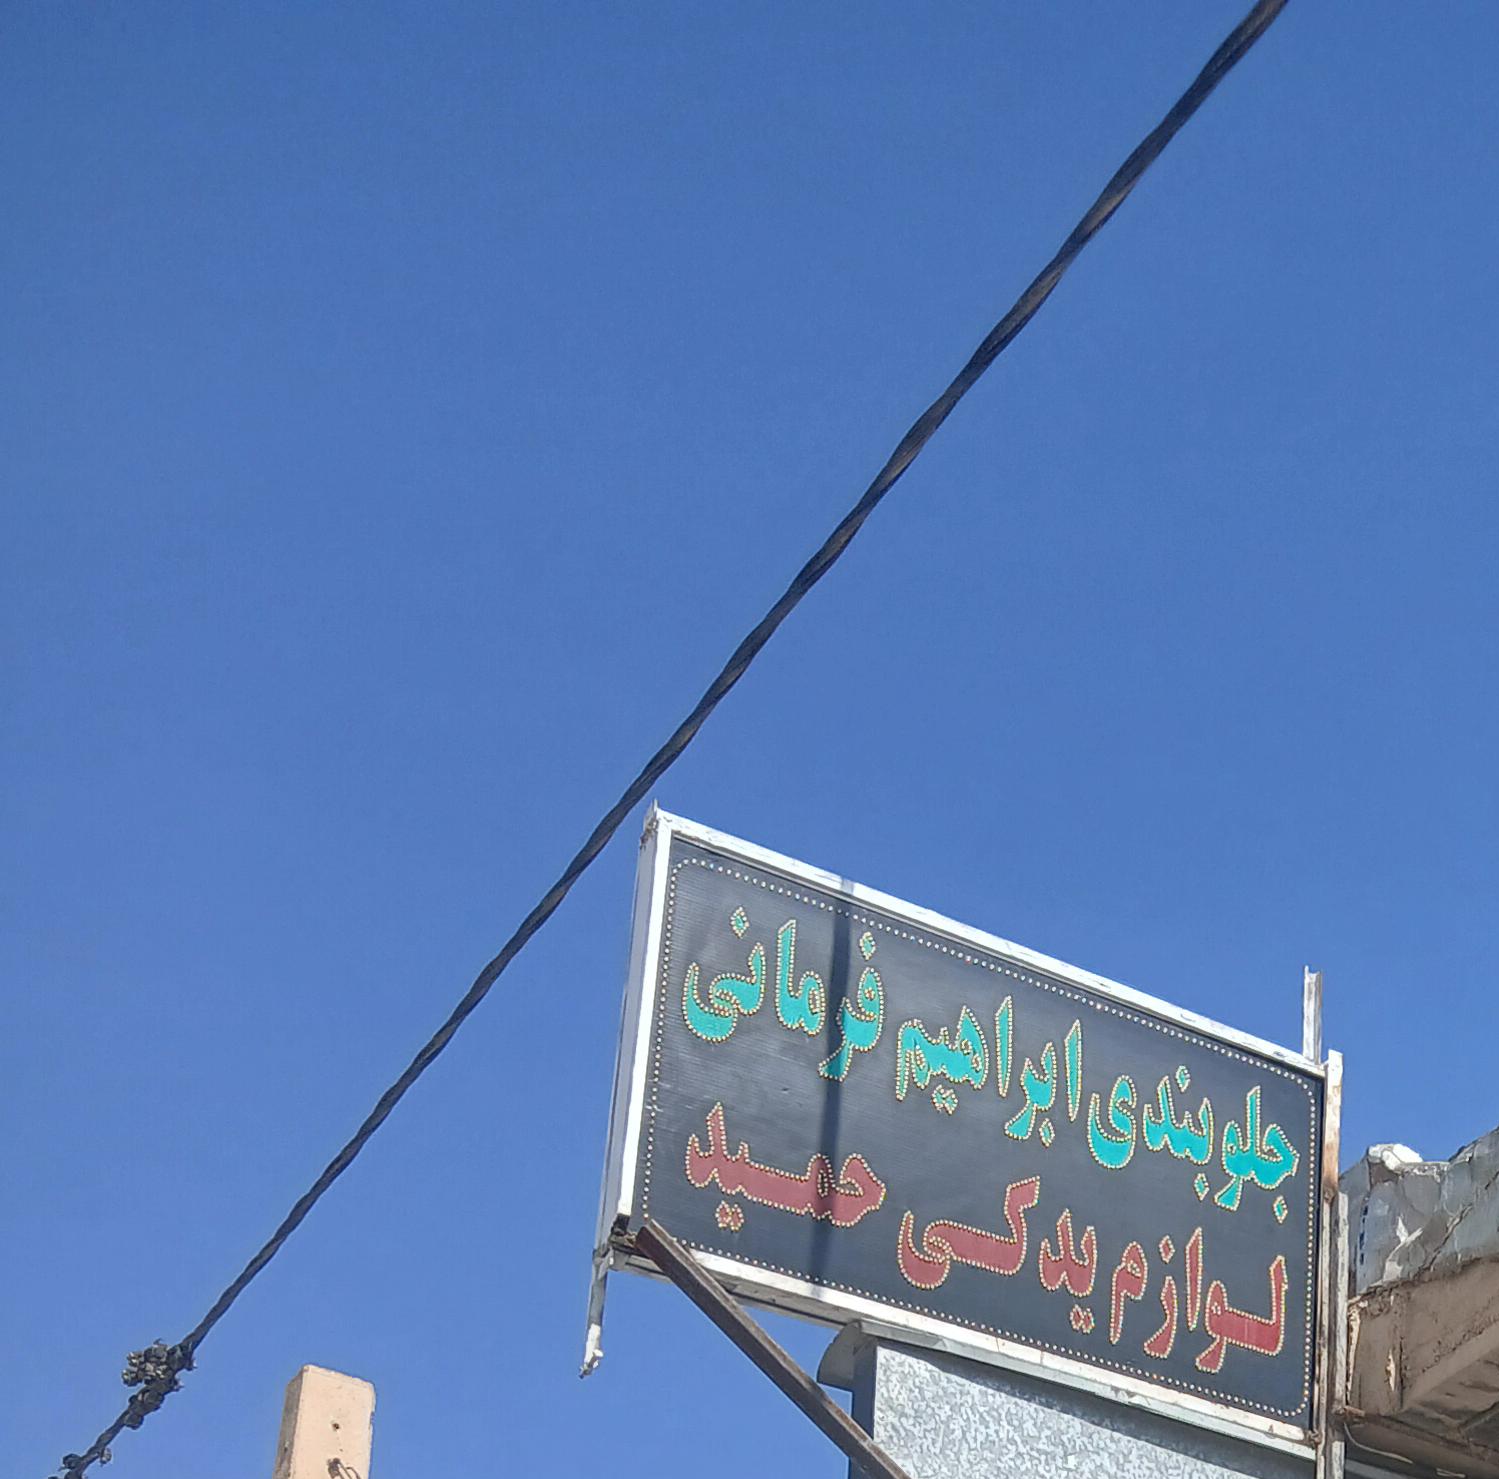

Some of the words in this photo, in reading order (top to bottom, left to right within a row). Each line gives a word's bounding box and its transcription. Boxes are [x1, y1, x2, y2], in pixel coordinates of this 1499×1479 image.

[682, 906, 885, 1083] فرمانی
[896, 995, 1083, 1147] ابراهیم
[685, 1102, 888, 1233] حمید
[898, 1175, 1098, 1334] یدکی
[1109, 1226, 1289, 1373] لوازم
